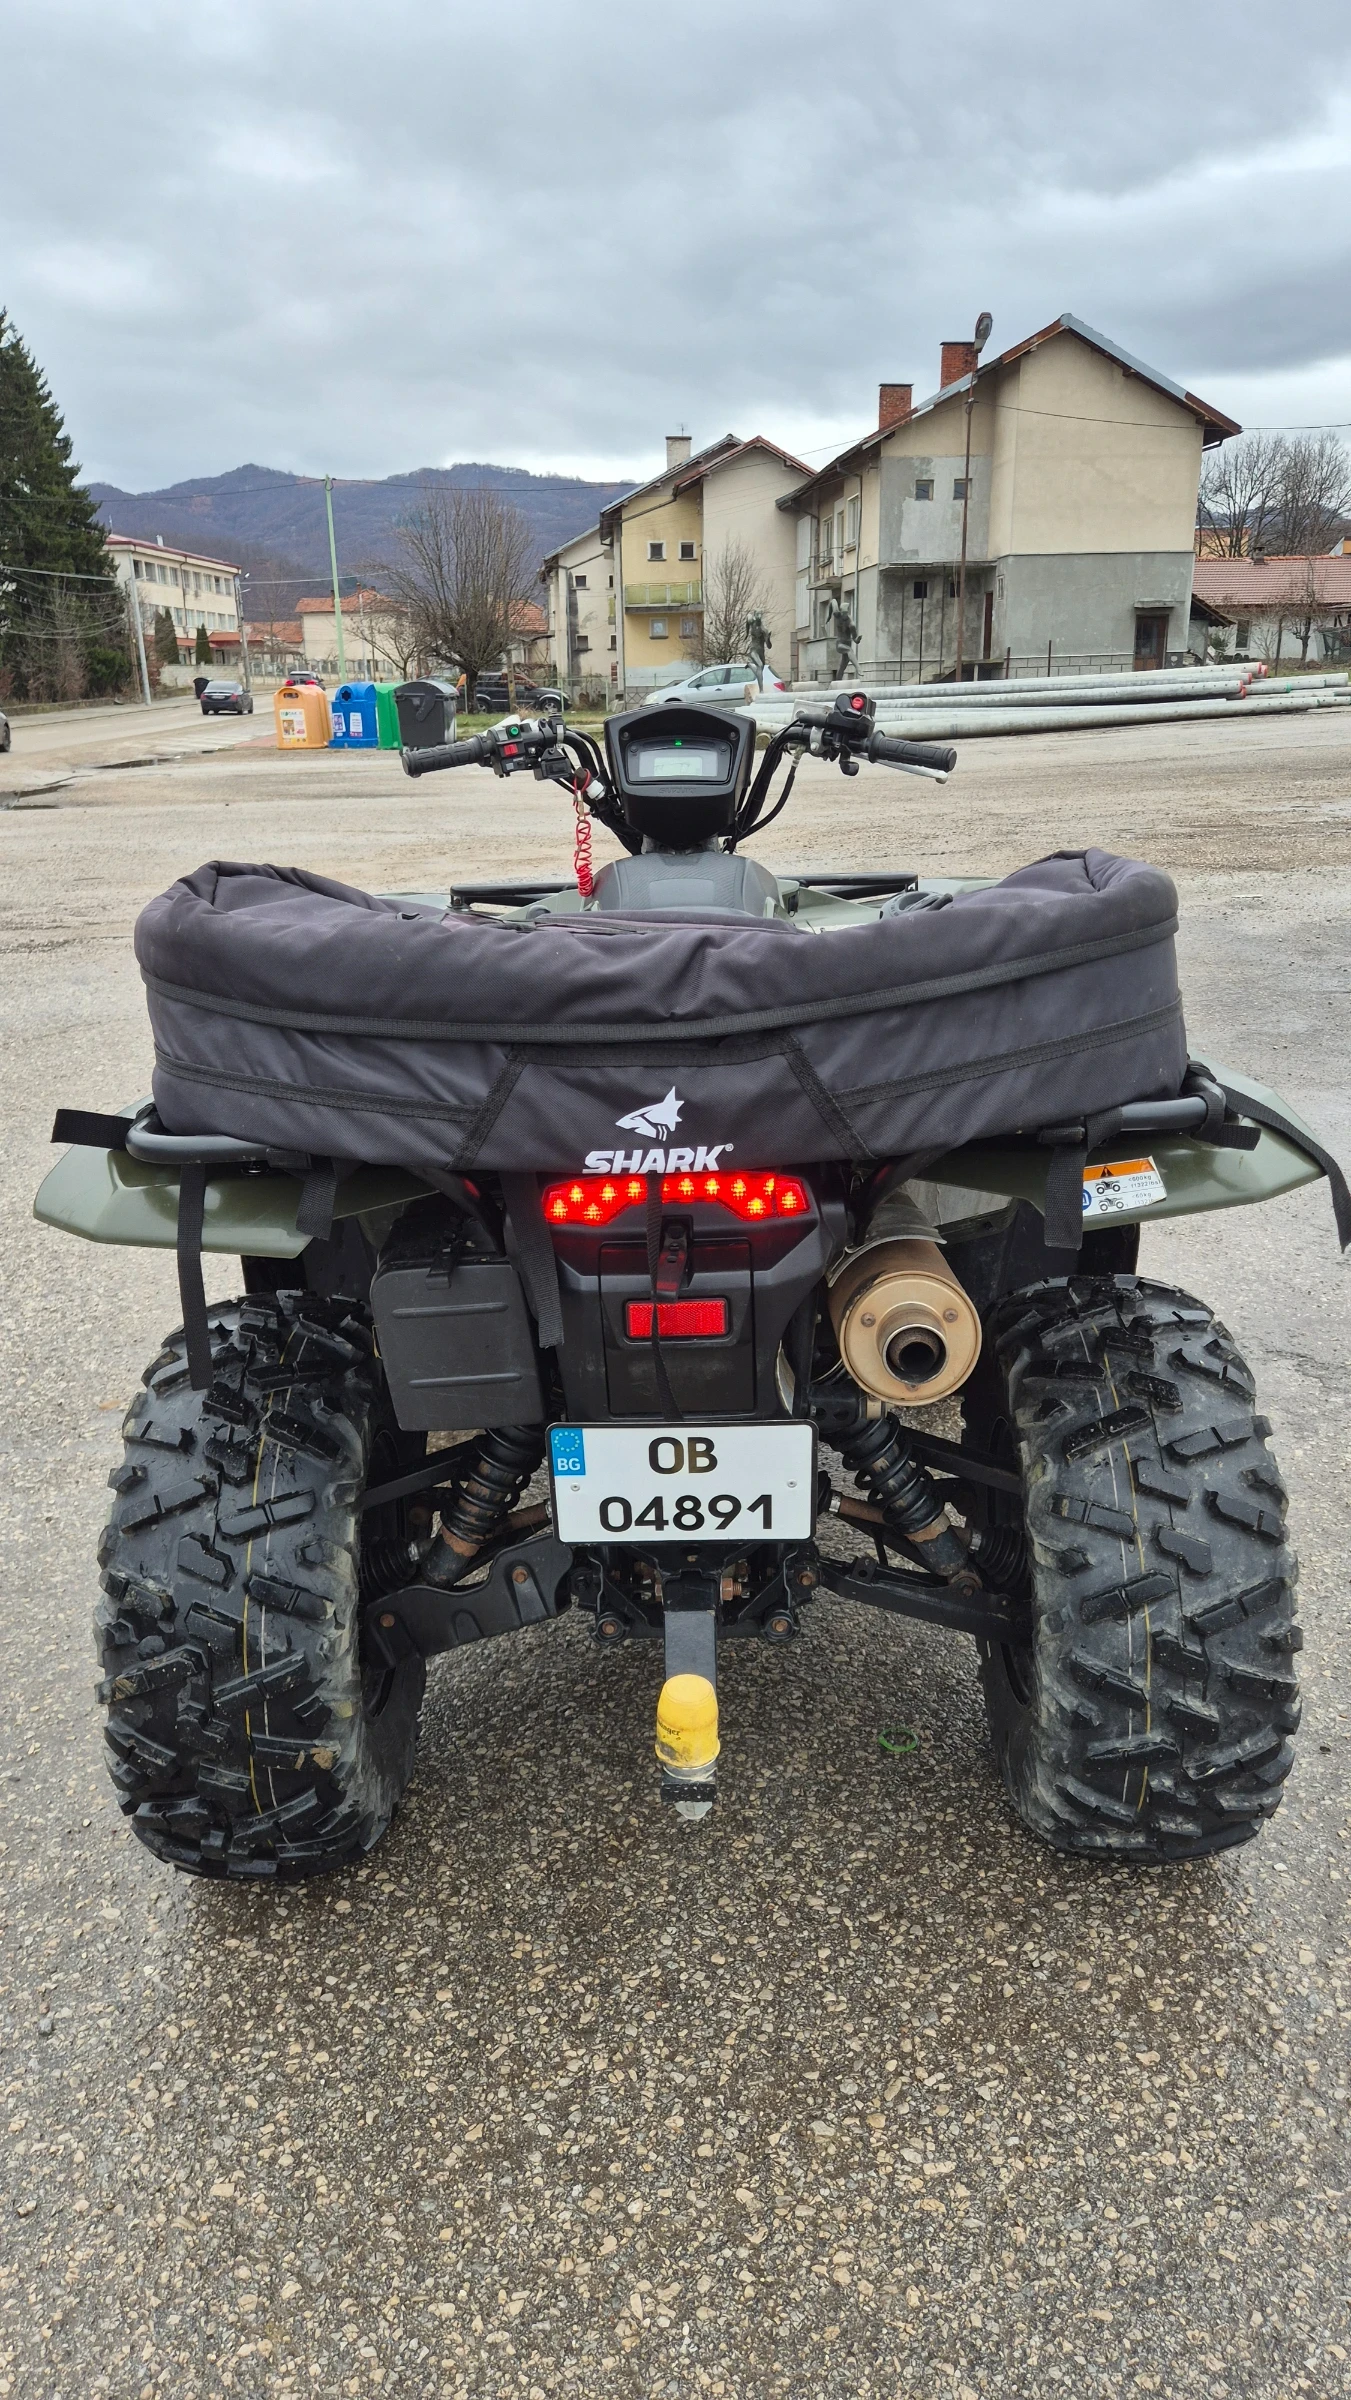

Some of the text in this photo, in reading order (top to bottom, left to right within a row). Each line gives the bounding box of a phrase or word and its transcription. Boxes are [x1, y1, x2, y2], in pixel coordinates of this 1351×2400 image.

[557, 1457, 581, 1471] BG
[648, 1436, 718, 1474] OB
[599, 1494, 772, 1532] 04891
